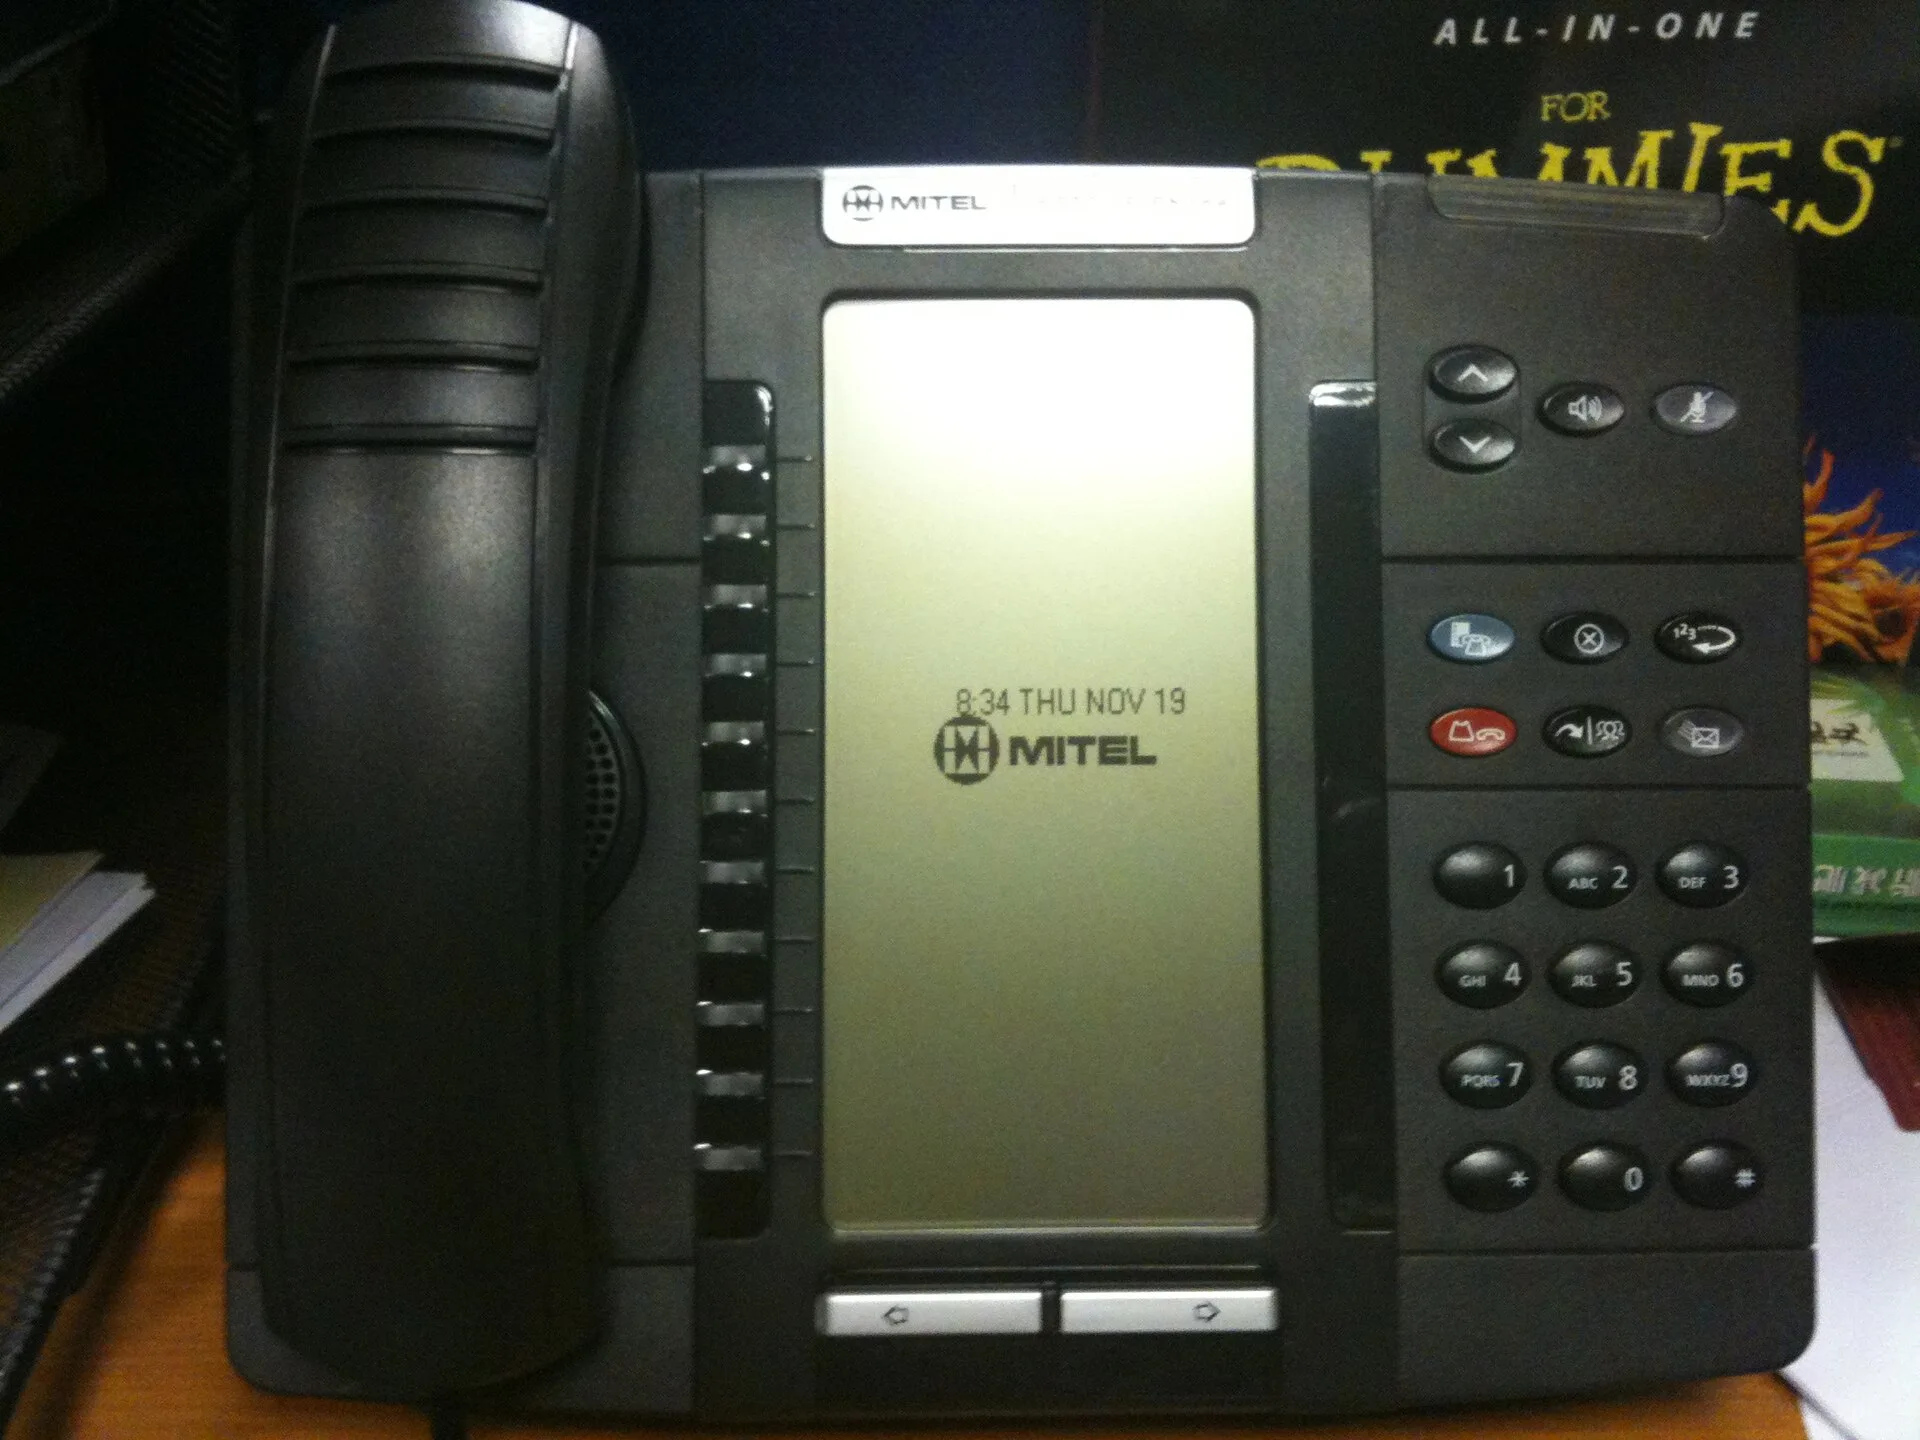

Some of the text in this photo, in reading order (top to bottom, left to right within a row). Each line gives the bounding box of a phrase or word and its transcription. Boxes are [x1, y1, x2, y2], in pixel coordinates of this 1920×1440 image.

[1433, 11, 1761, 46] ALL-IN-ONE
[1540, 90, 1611, 122] FOR
[890, 195, 987, 211] MITEL
[955, 686, 1187, 716] 8:34 THU NOV 19
[1008, 735, 1158, 767] MITEL
[1504, 864, 1514, 888] 1
[1567, 865, 1628, 890] ABC 2
[1678, 865, 1739, 889] DEF 3
[1458, 962, 1522, 987] GHI 4
[1615, 961, 1633, 986] 5
[1681, 963, 1744, 987] MNO 6
[1505, 1062, 1524, 1087] 7
[1574, 1064, 1639, 1091] TUV 8
[1728, 1062, 1749, 1088] 9
[1624, 1166, 1644, 1192] 0
